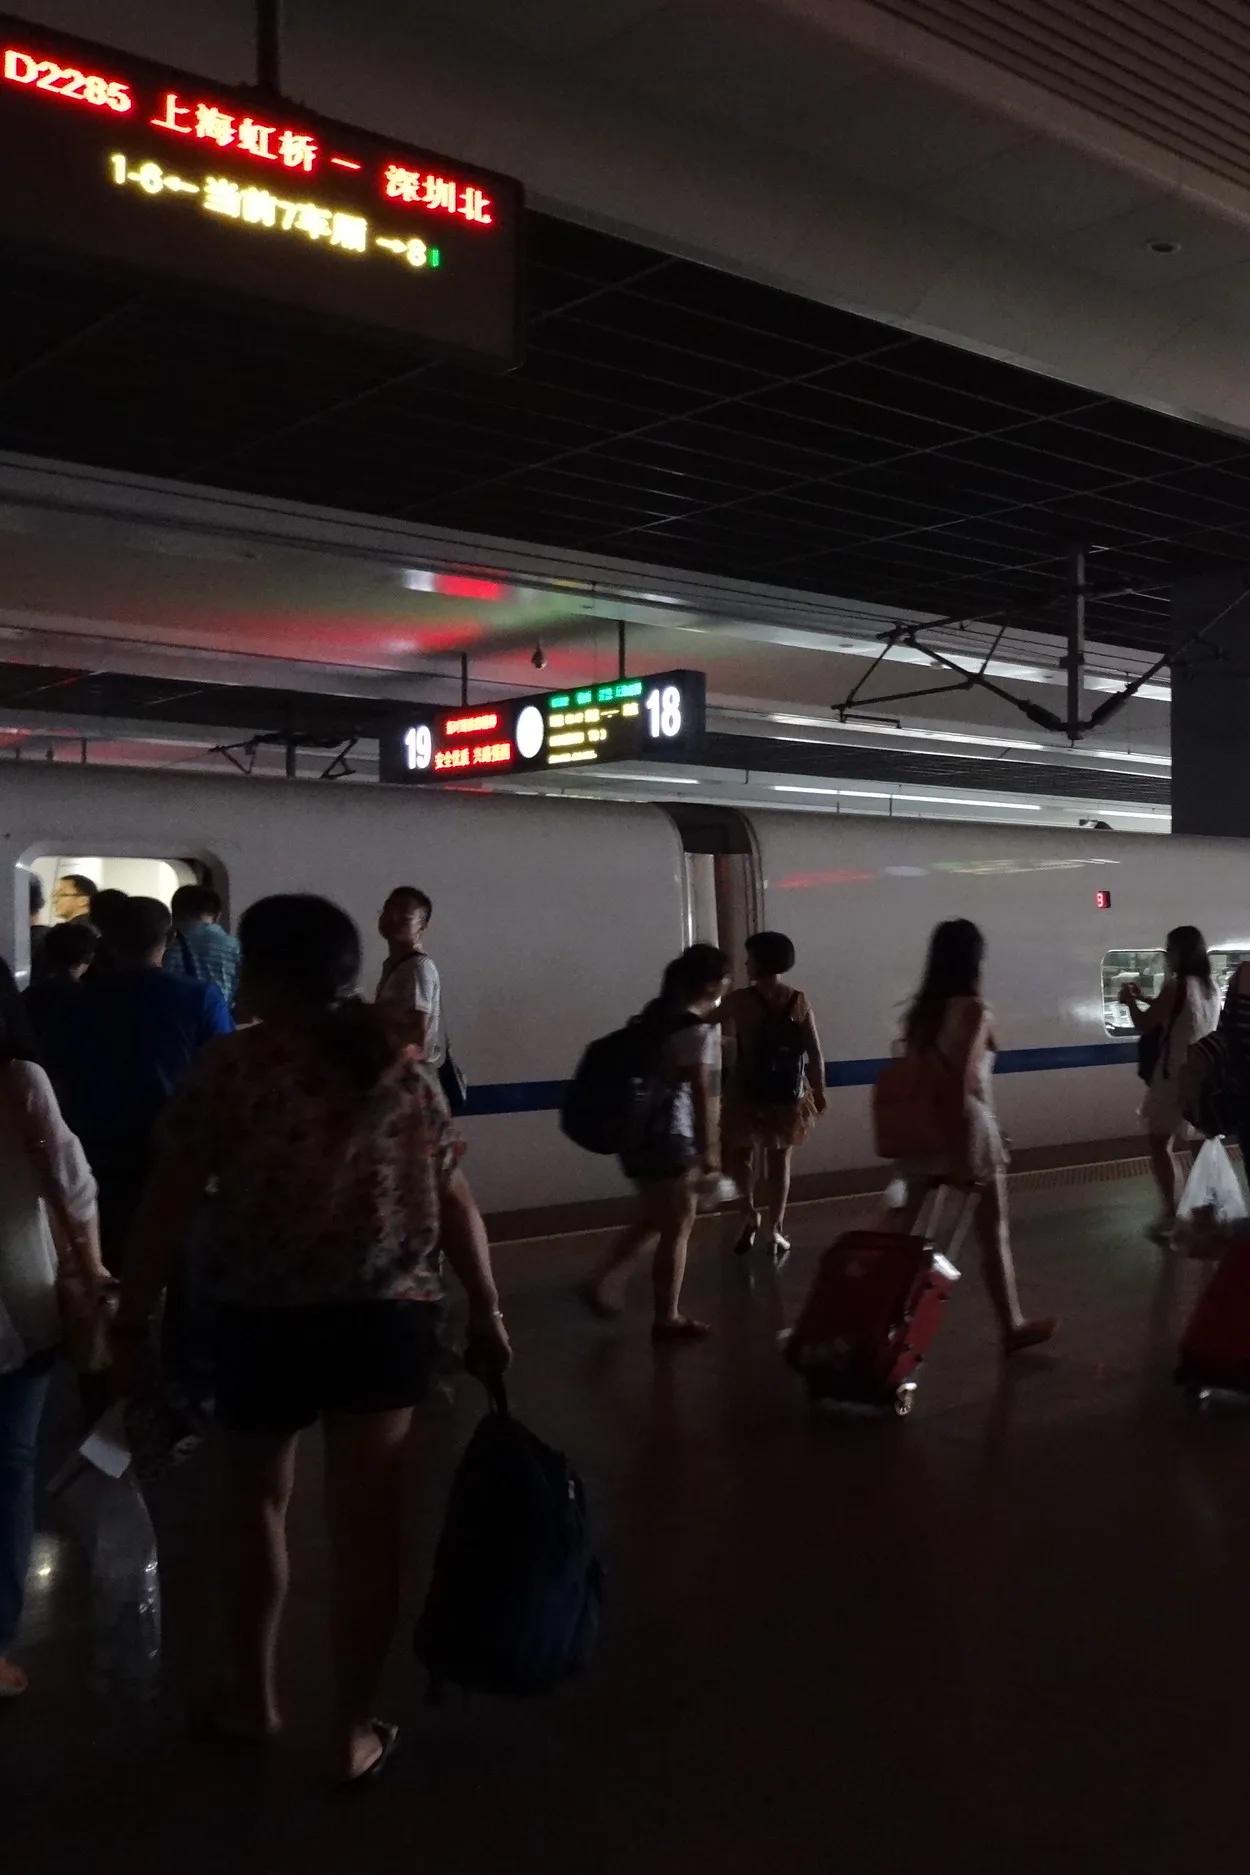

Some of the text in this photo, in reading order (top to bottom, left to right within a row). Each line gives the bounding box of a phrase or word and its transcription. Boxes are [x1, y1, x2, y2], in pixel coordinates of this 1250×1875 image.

[4, 49, 492, 224] D2285 上海虹桥 深圳北
[645, 686, 682, 738] 18
[404, 725, 435, 770] 19
